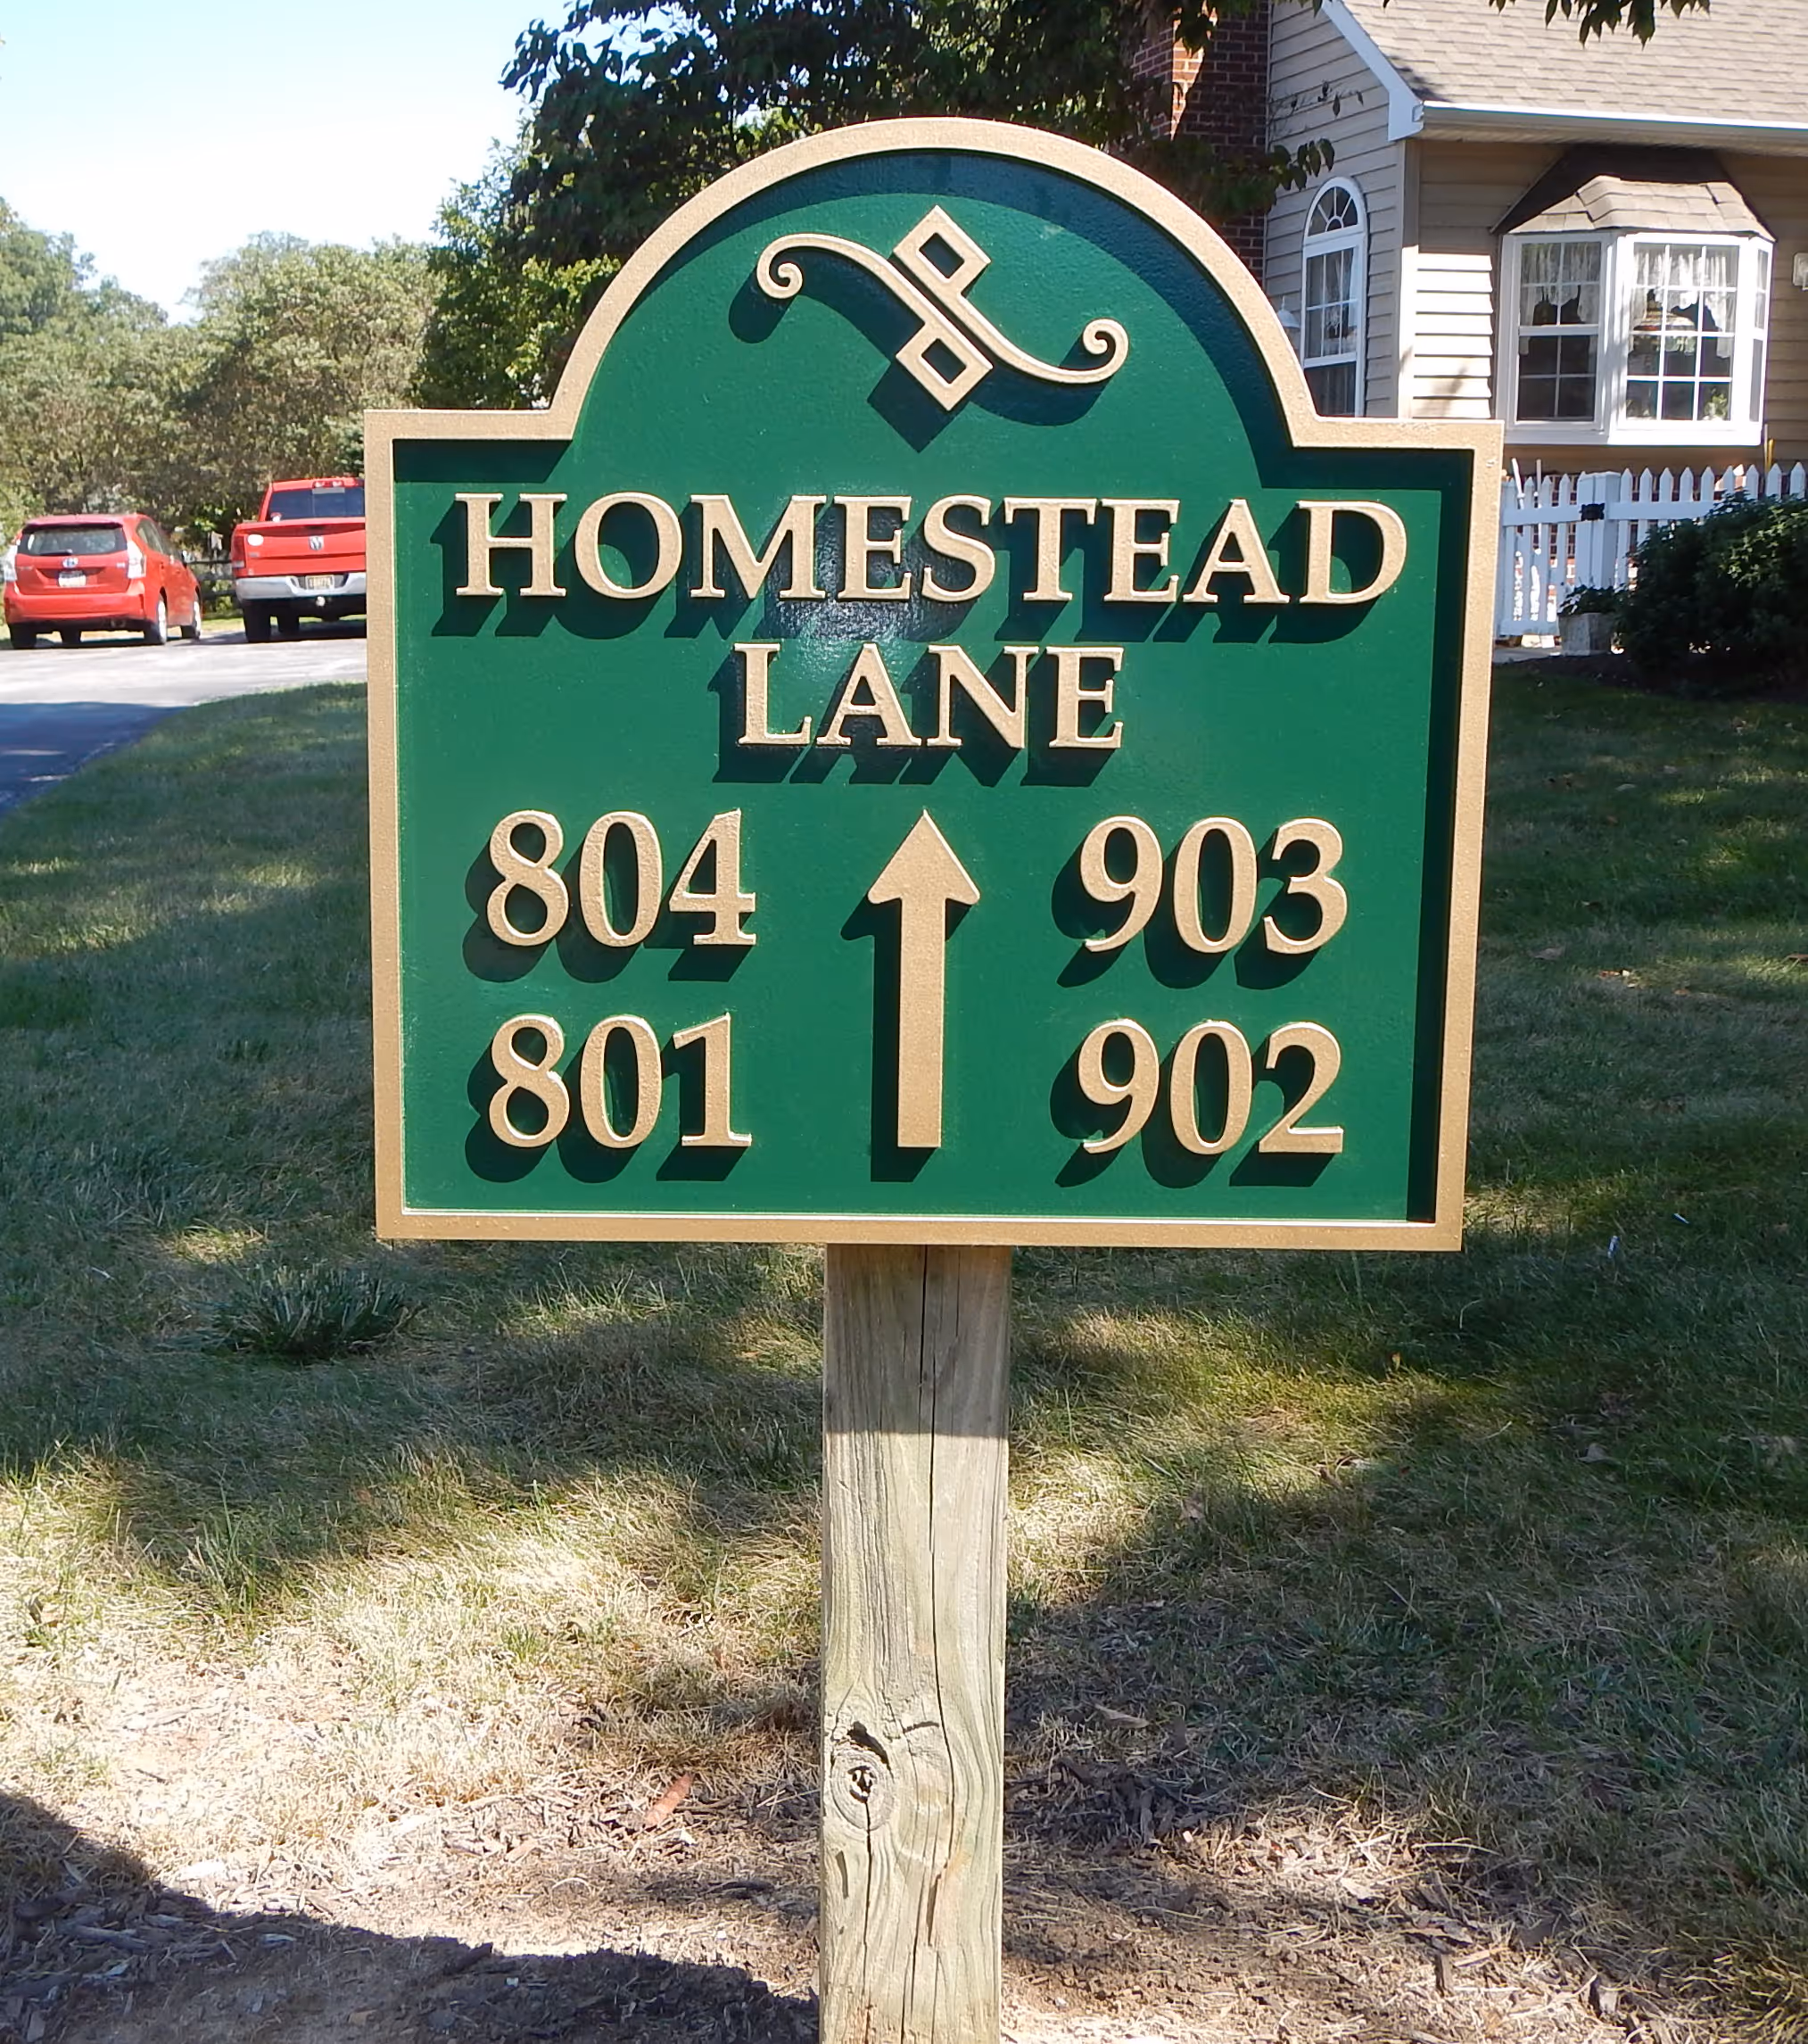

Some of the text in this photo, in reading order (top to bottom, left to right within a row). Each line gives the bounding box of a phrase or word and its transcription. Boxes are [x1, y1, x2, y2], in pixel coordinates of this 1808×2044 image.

[455, 492, 1408, 605] HOMESTEAD
[733, 642, 1125, 750] LANE
[485, 808, 756, 948] 804
[1079, 814, 1349, 956] 903
[488, 1013, 753, 1148] 801
[1077, 1017, 1345, 1156] 902
